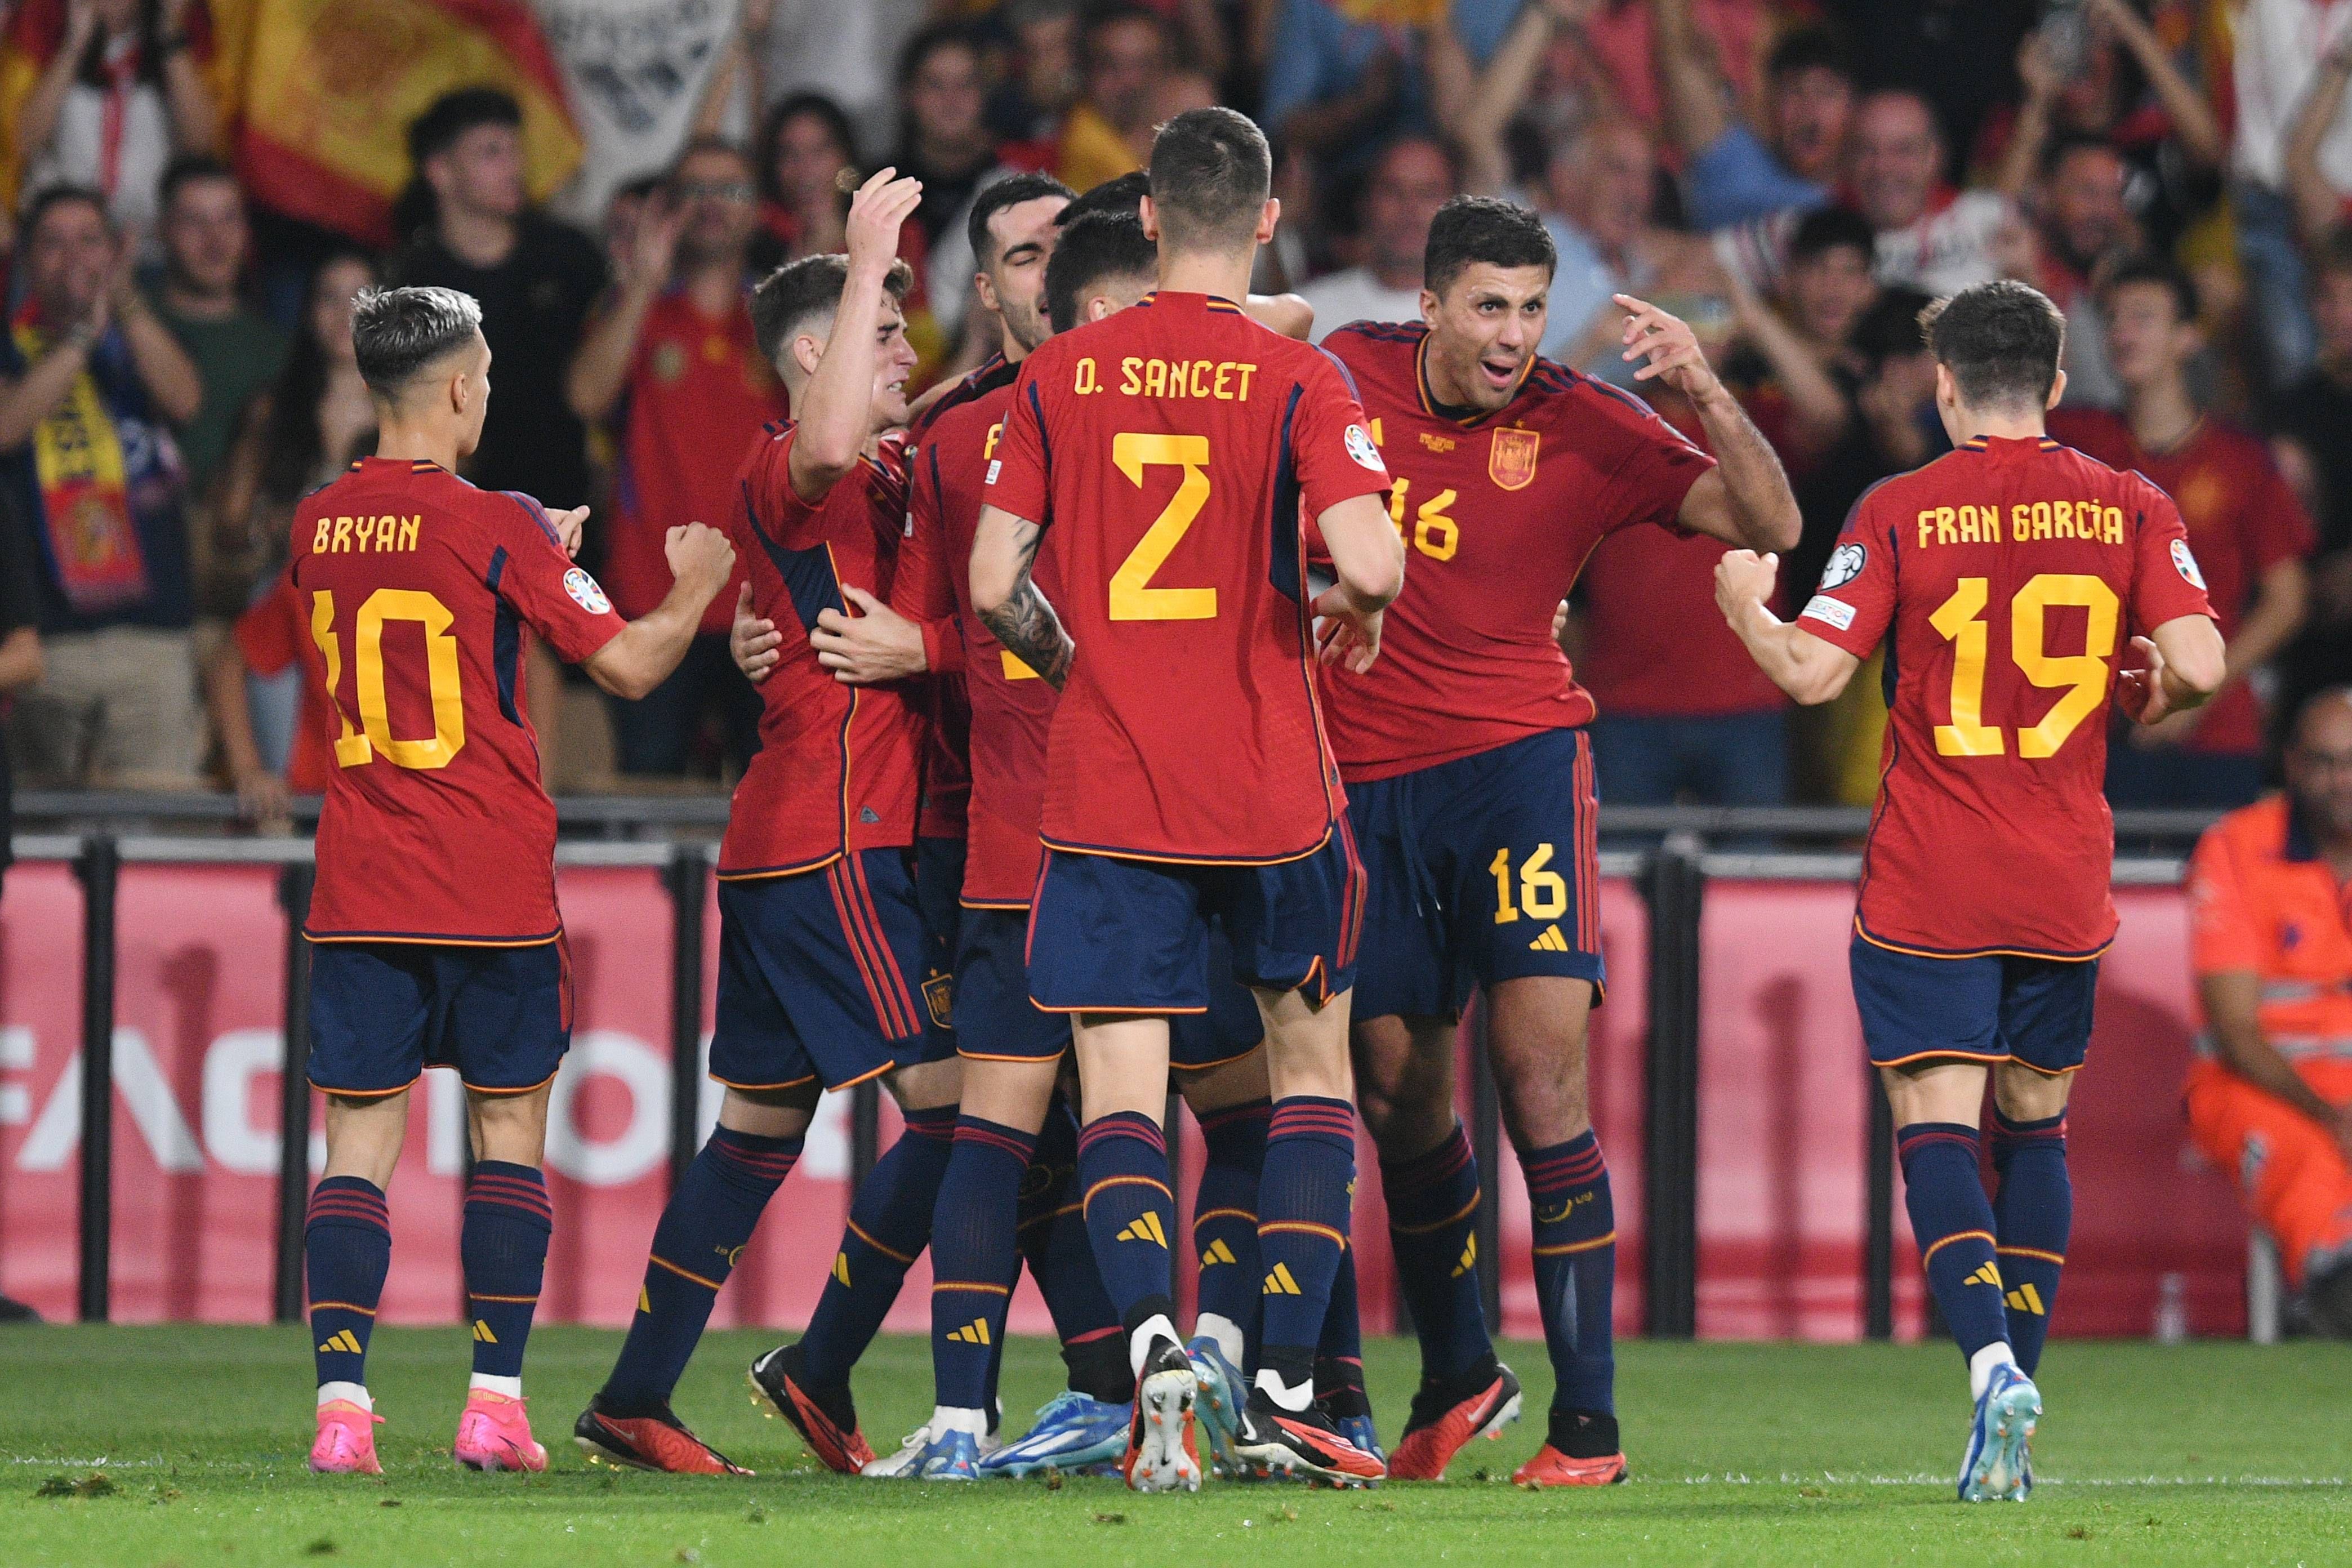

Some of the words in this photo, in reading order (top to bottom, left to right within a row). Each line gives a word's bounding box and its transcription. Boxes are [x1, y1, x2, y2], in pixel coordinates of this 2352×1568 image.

[1120, 357, 1257, 402] SANCET
[313, 514, 422, 554] BRYAN
[1108, 432, 1218, 621] 2
[1389, 477, 1460, 563] 16
[1918, 505, 2001, 549] FRAN
[2011, 498, 2124, 545] GARCÍA
[311, 587, 466, 770] 10
[1928, 573, 2121, 759] 19
[1489, 843, 1567, 925] 16
